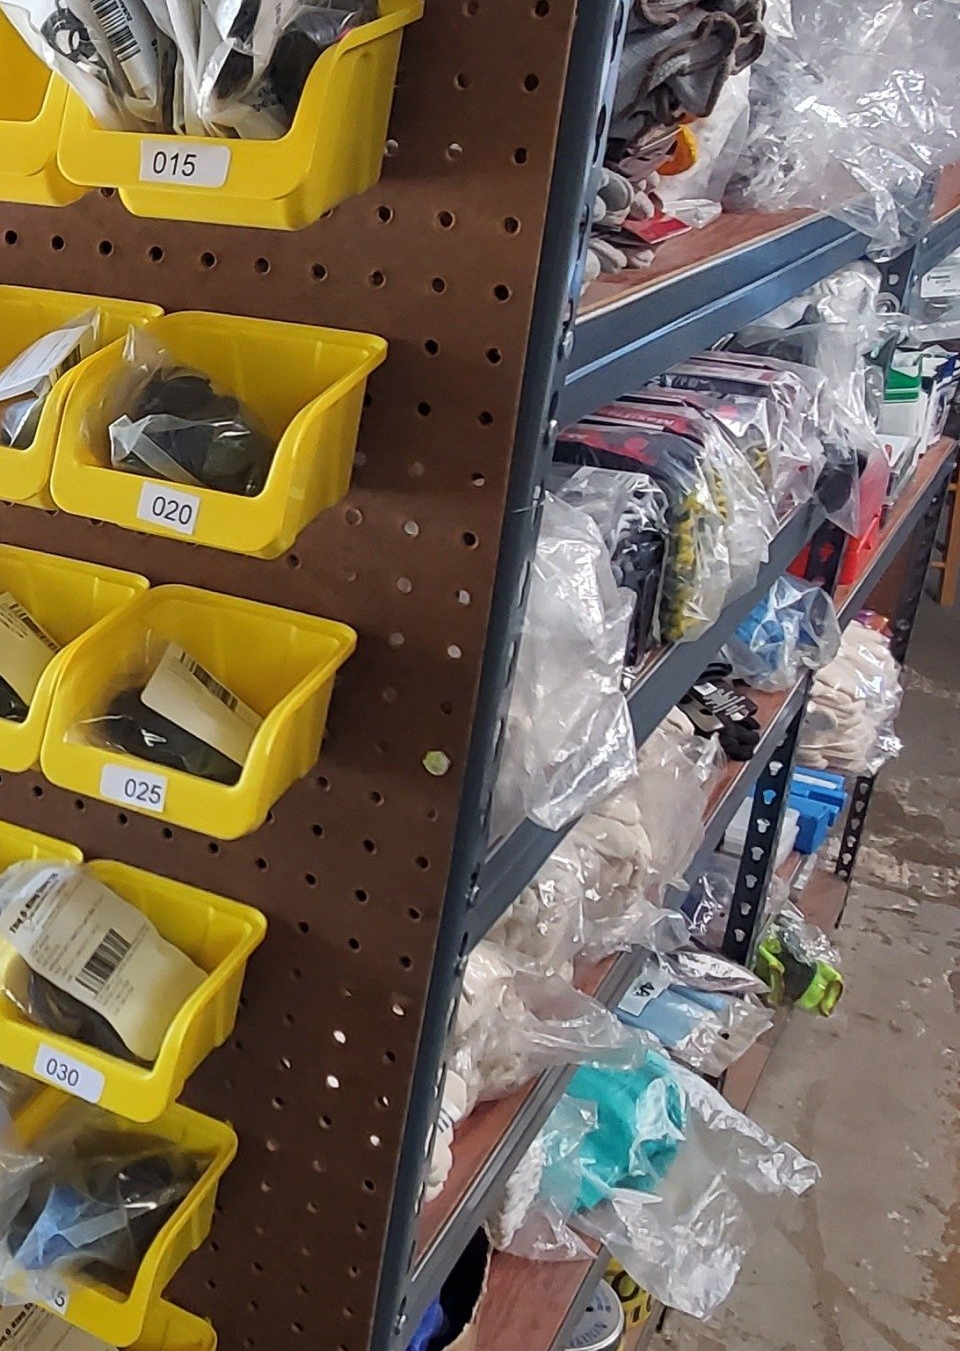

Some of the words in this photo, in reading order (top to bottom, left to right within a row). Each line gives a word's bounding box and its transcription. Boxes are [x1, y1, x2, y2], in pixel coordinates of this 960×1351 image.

[151, 151, 197, 178] 015
[151, 494, 193, 527] 020
[123, 777, 163, 806] 025
[45, 1057, 80, 1087] 030
